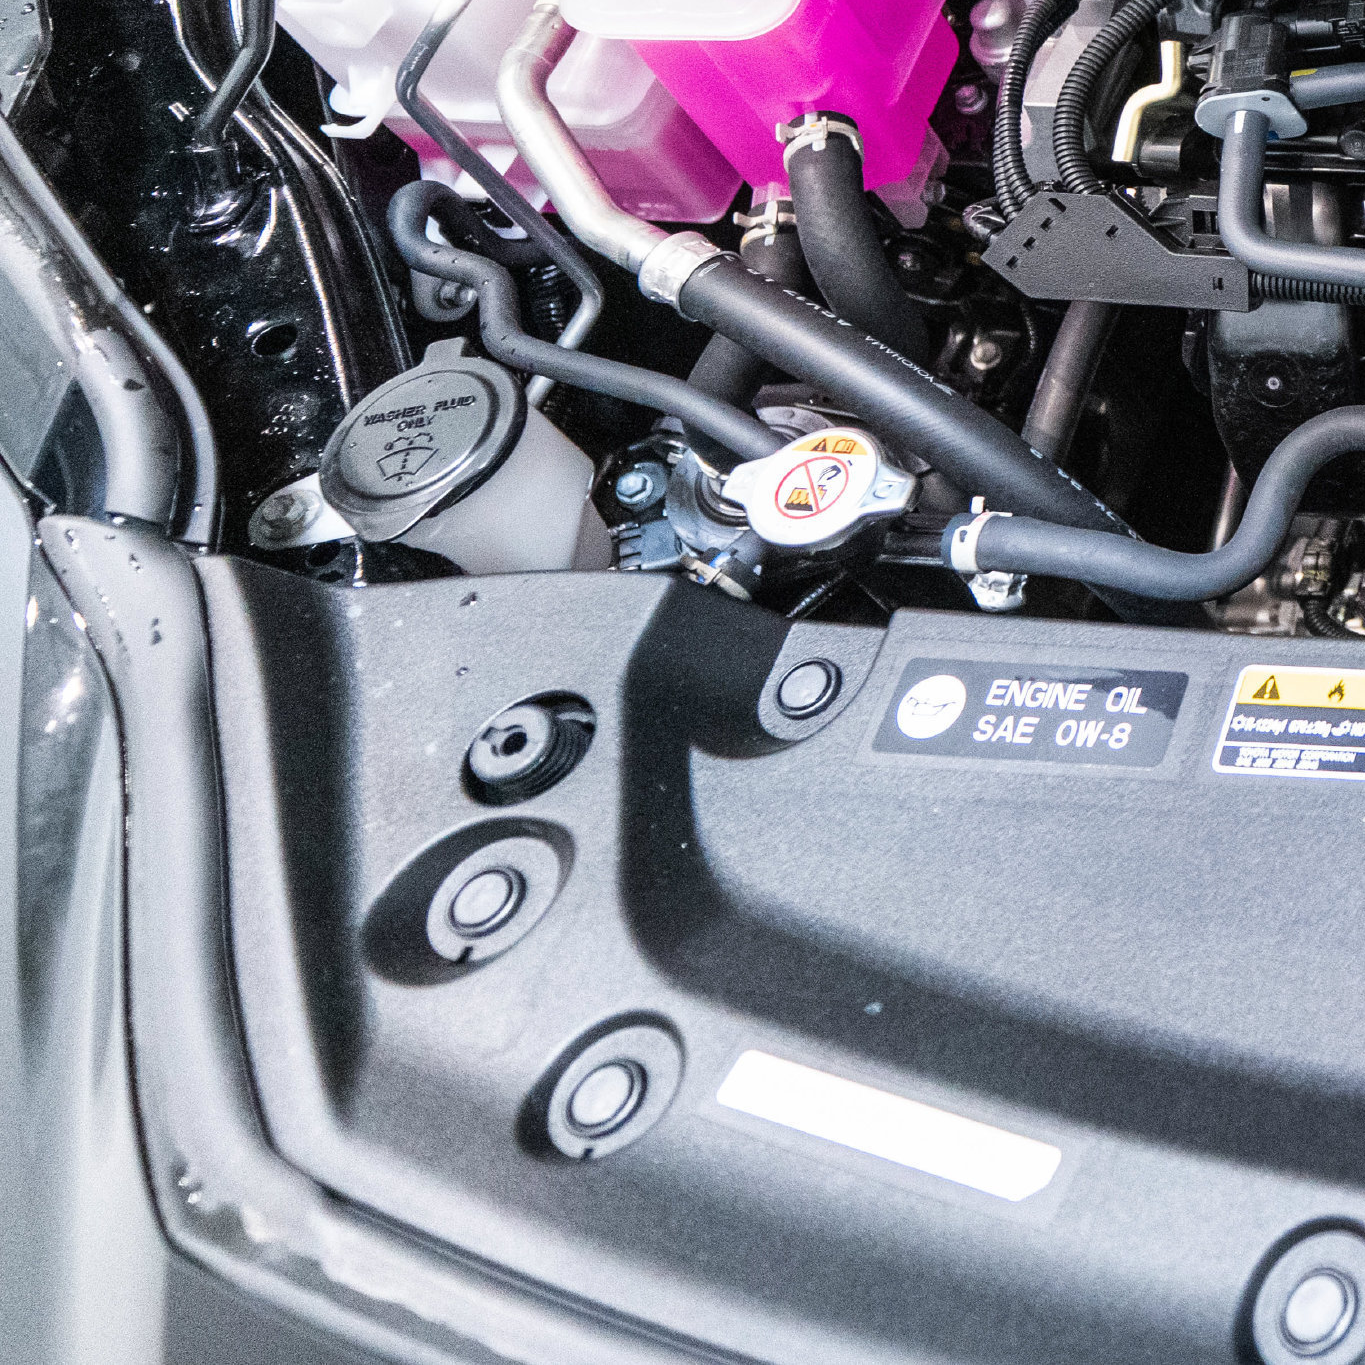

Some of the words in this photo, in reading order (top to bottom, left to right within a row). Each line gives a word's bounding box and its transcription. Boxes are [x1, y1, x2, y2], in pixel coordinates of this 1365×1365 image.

[864, 334, 935, 384] YOKOHAMA
[363, 405, 428, 426] WASHER
[432, 394, 476, 413] FLUID
[396, 415, 437, 432] ONLY
[986, 679, 1092, 711] ENGINE
[1105, 686, 1148, 714] OIL
[973, 714, 1040, 744] SAE
[1055, 719, 1132, 750] 0W-8
